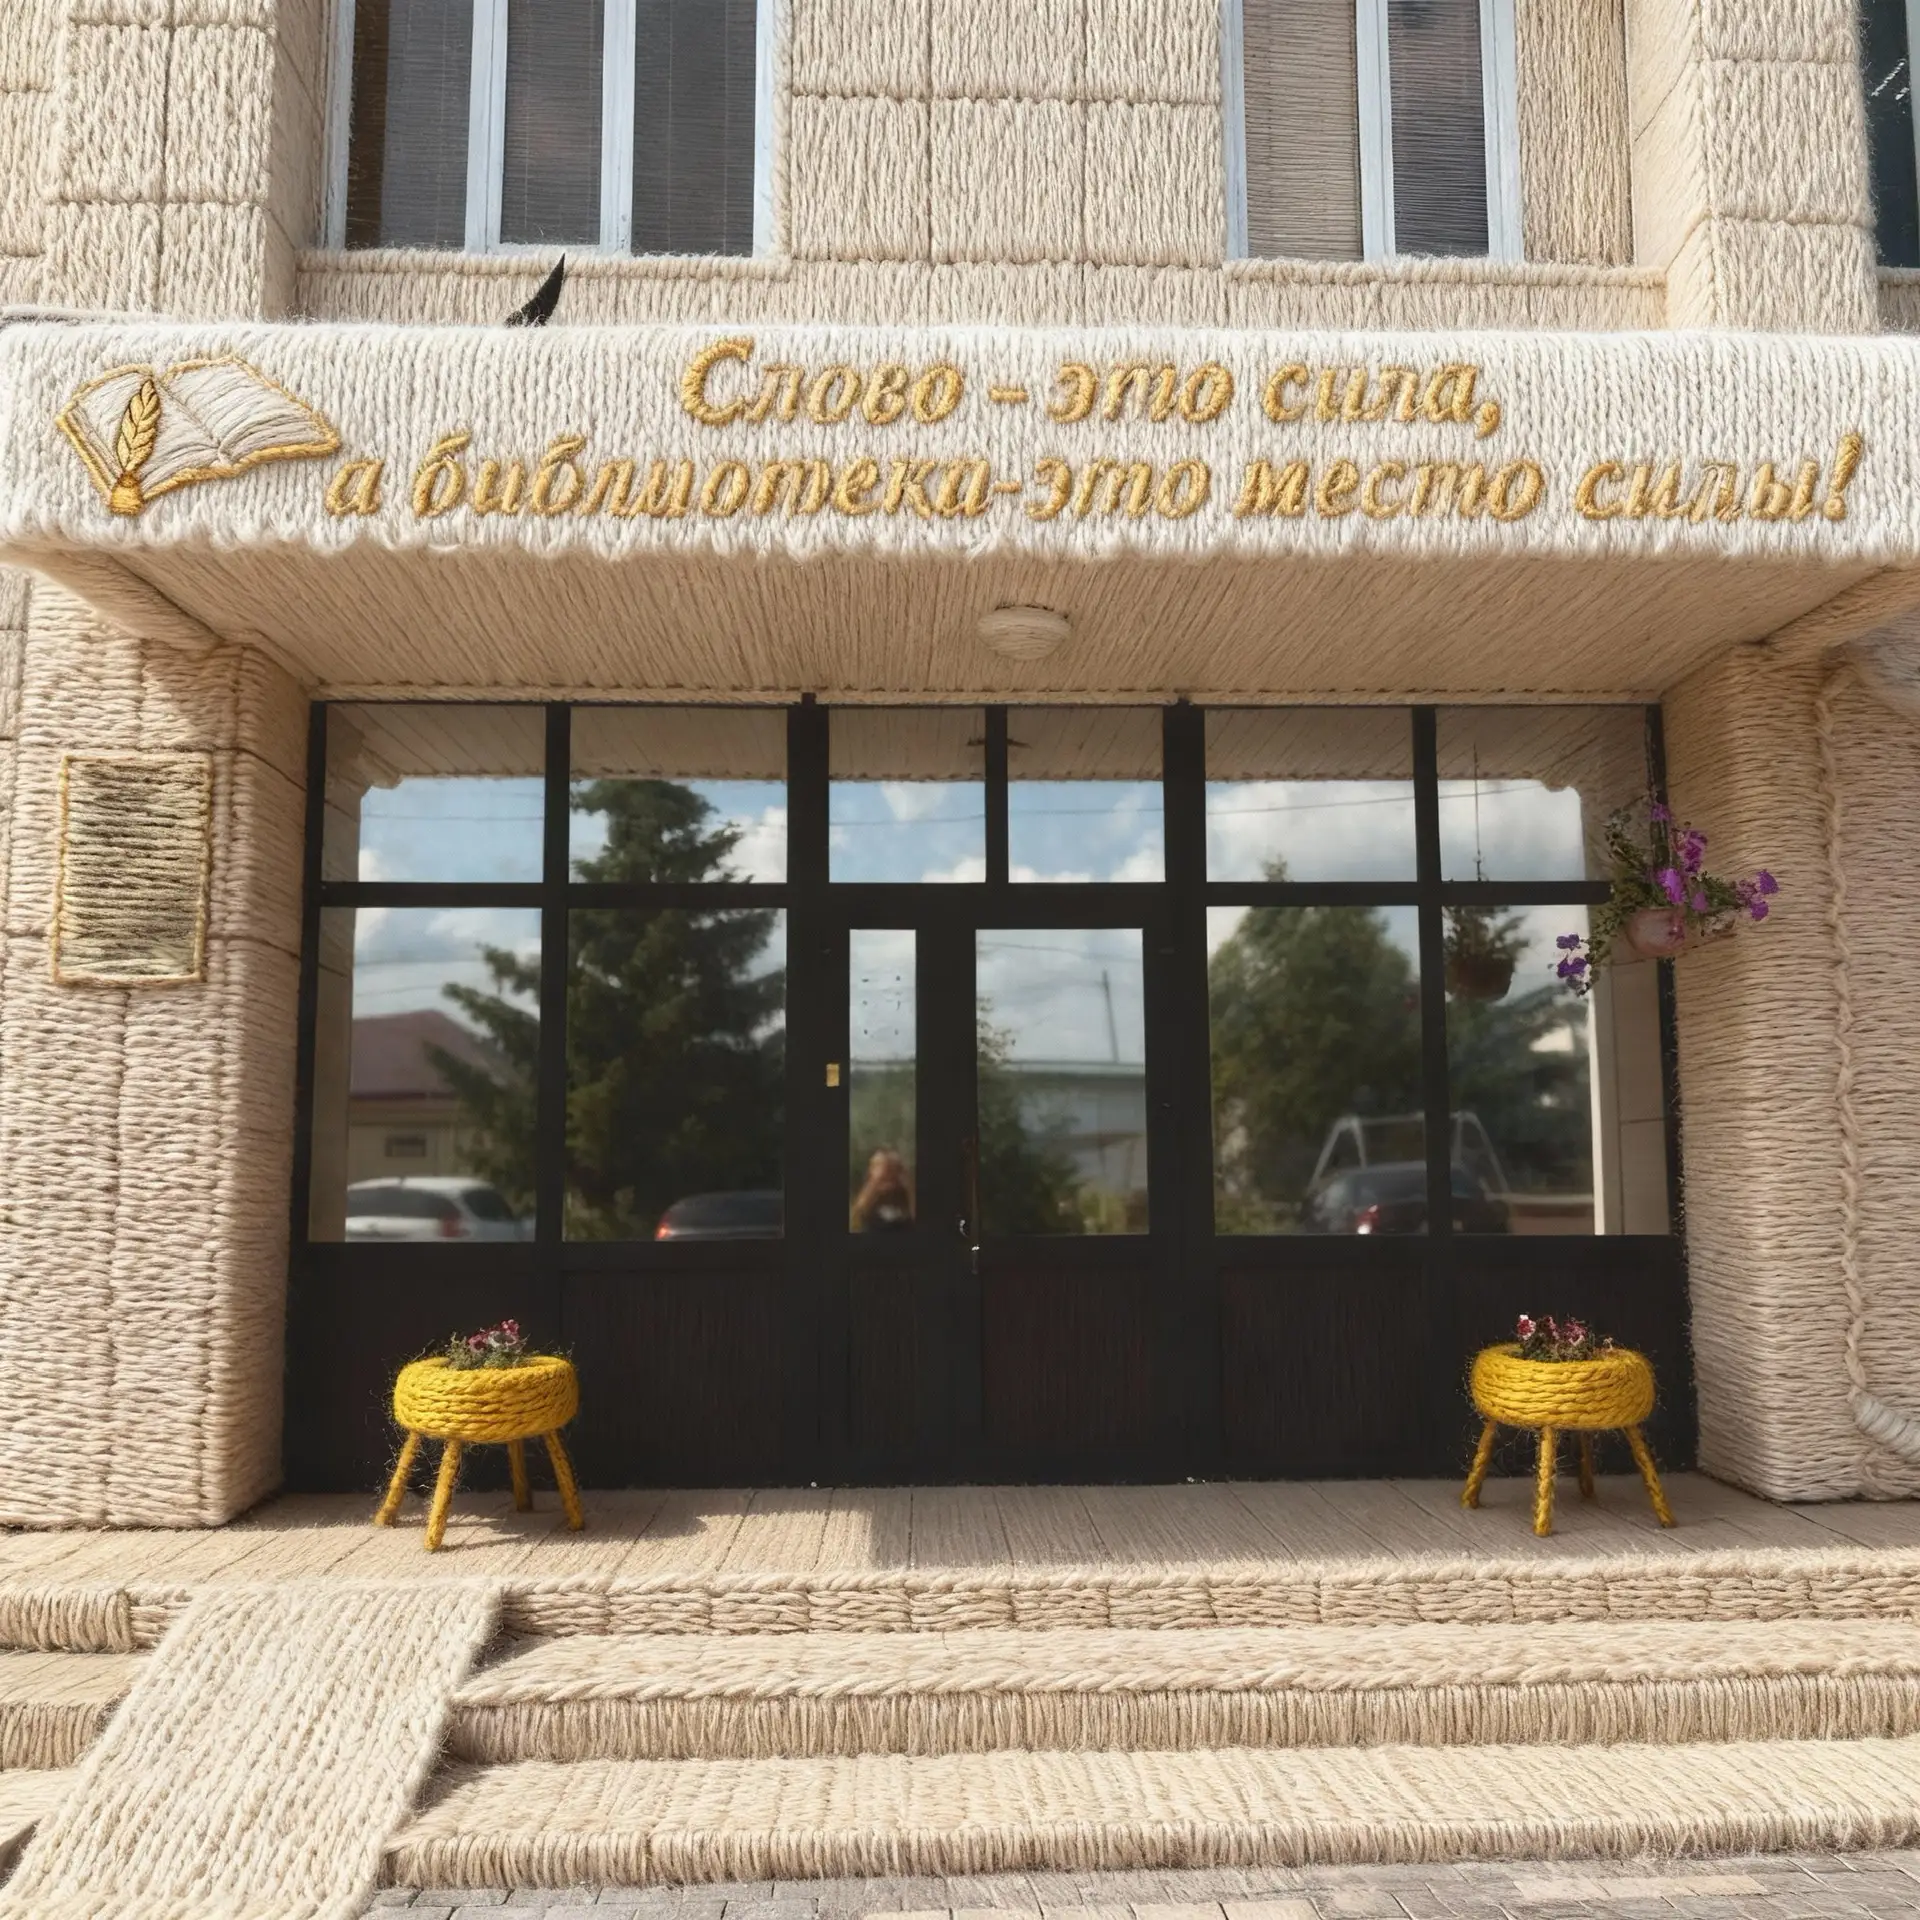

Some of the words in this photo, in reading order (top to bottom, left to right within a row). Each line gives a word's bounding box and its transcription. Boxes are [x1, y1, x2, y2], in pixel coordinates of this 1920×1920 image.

[680, 336, 966, 425] Слово
[988, 386, 1028, 403] -
[1047, 361, 1234, 424] это
[1264, 361, 1500, 440] сила,
[325, 457, 385, 517] а
[1234, 458, 1546, 521] место
[1575, 430, 1863, 522] силы!
